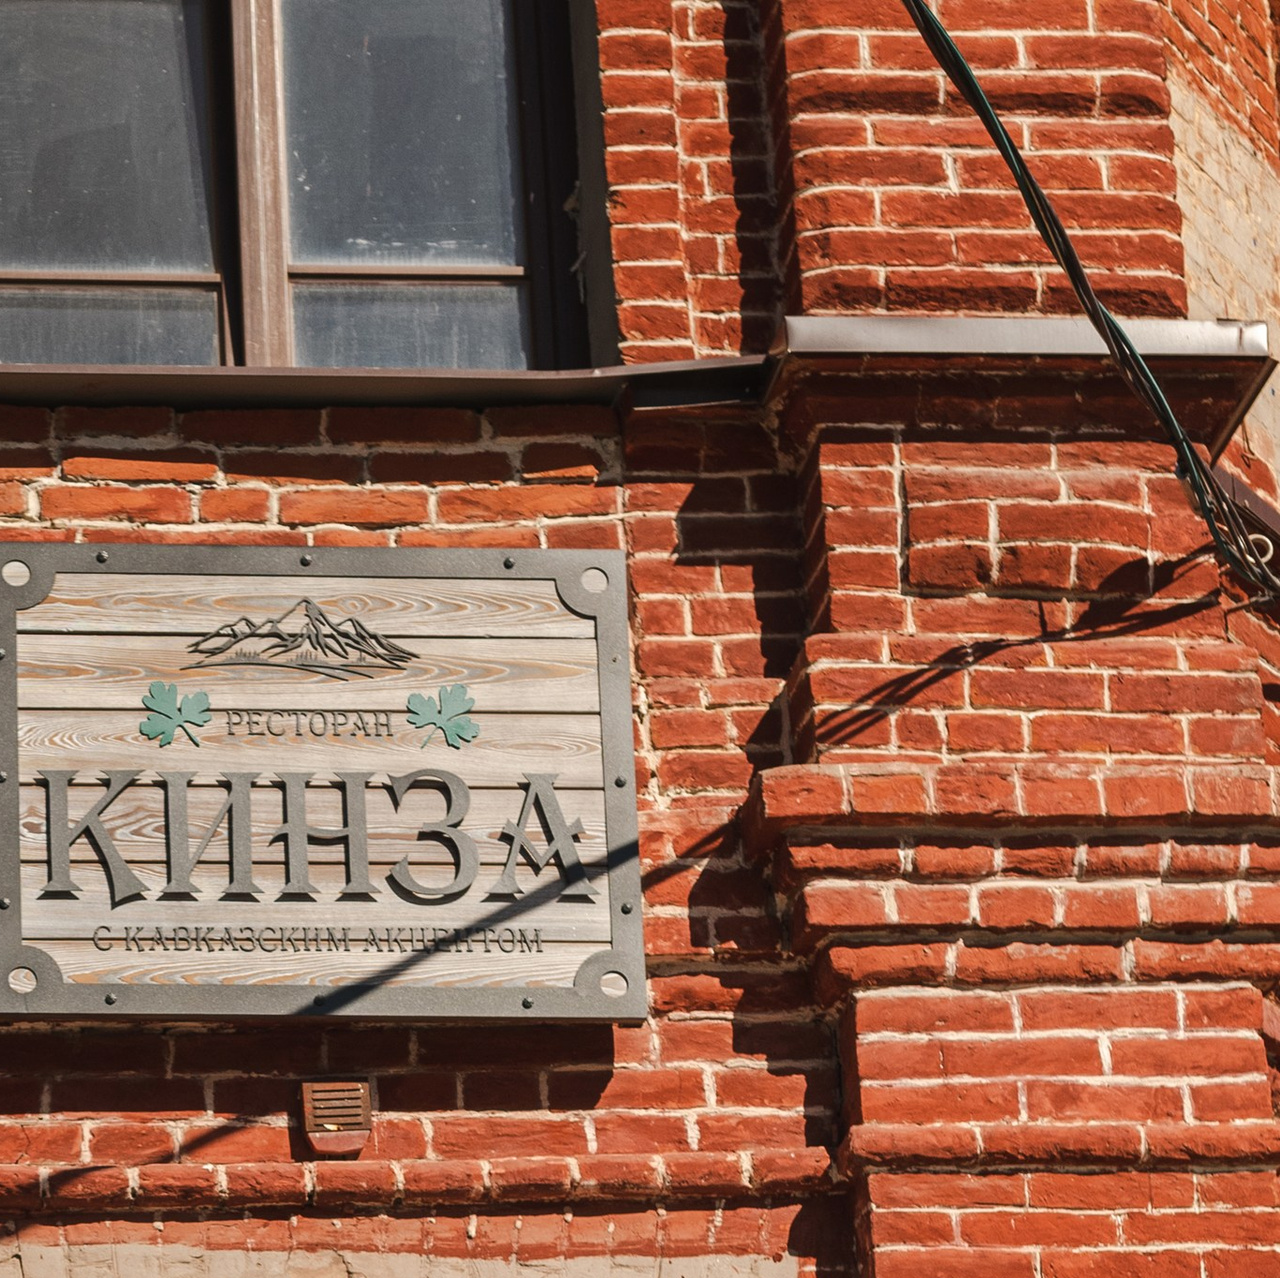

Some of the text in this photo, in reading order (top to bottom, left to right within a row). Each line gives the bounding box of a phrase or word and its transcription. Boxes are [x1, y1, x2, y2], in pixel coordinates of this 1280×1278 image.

[226, 710, 394, 738] РЕСТОРАН
[36, 768, 601, 908] КИНЗА
[92, 925, 544, 955] С КАВКАЗСКИМ АКЦЕНТОМ
